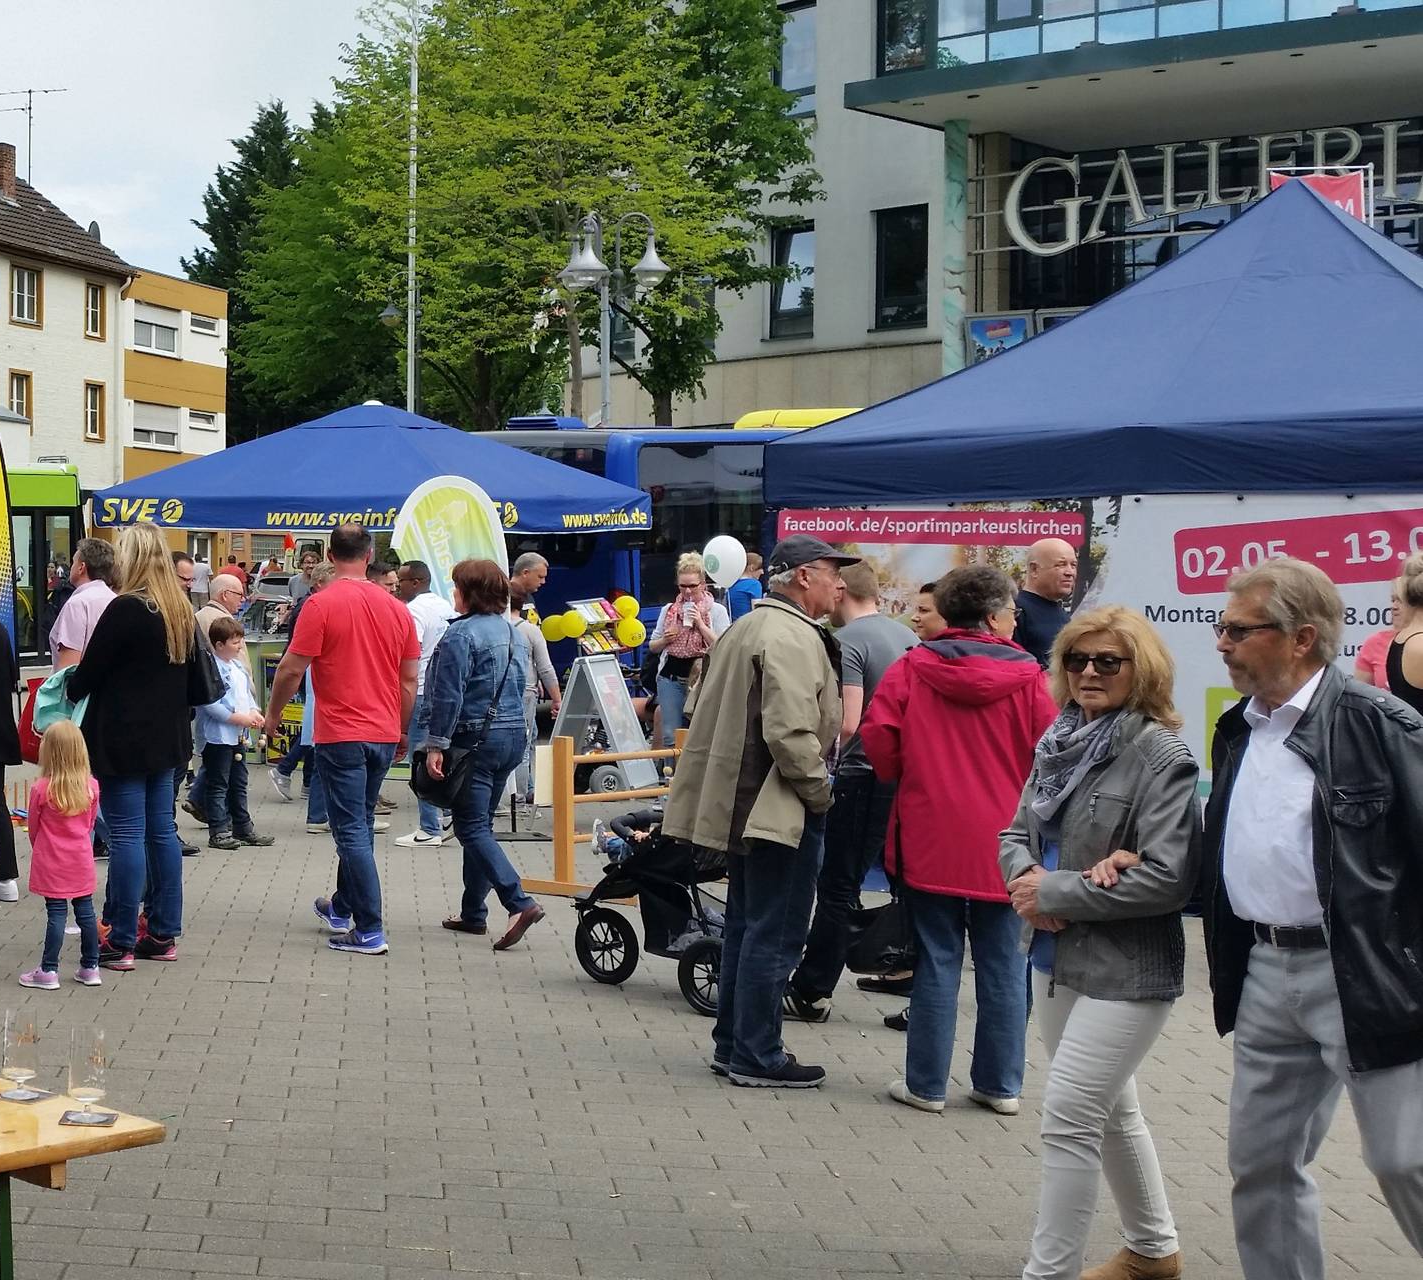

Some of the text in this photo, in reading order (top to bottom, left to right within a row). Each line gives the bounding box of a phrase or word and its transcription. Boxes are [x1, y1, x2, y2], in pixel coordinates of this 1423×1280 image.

[1003, 120, 1423, 257] GALLERI
[101, 498, 159, 522] SVE
[783, 516, 1083, 537] facebook.de/sportimparkeuskirchen
[1343, 607, 1394, 626] 8.00
